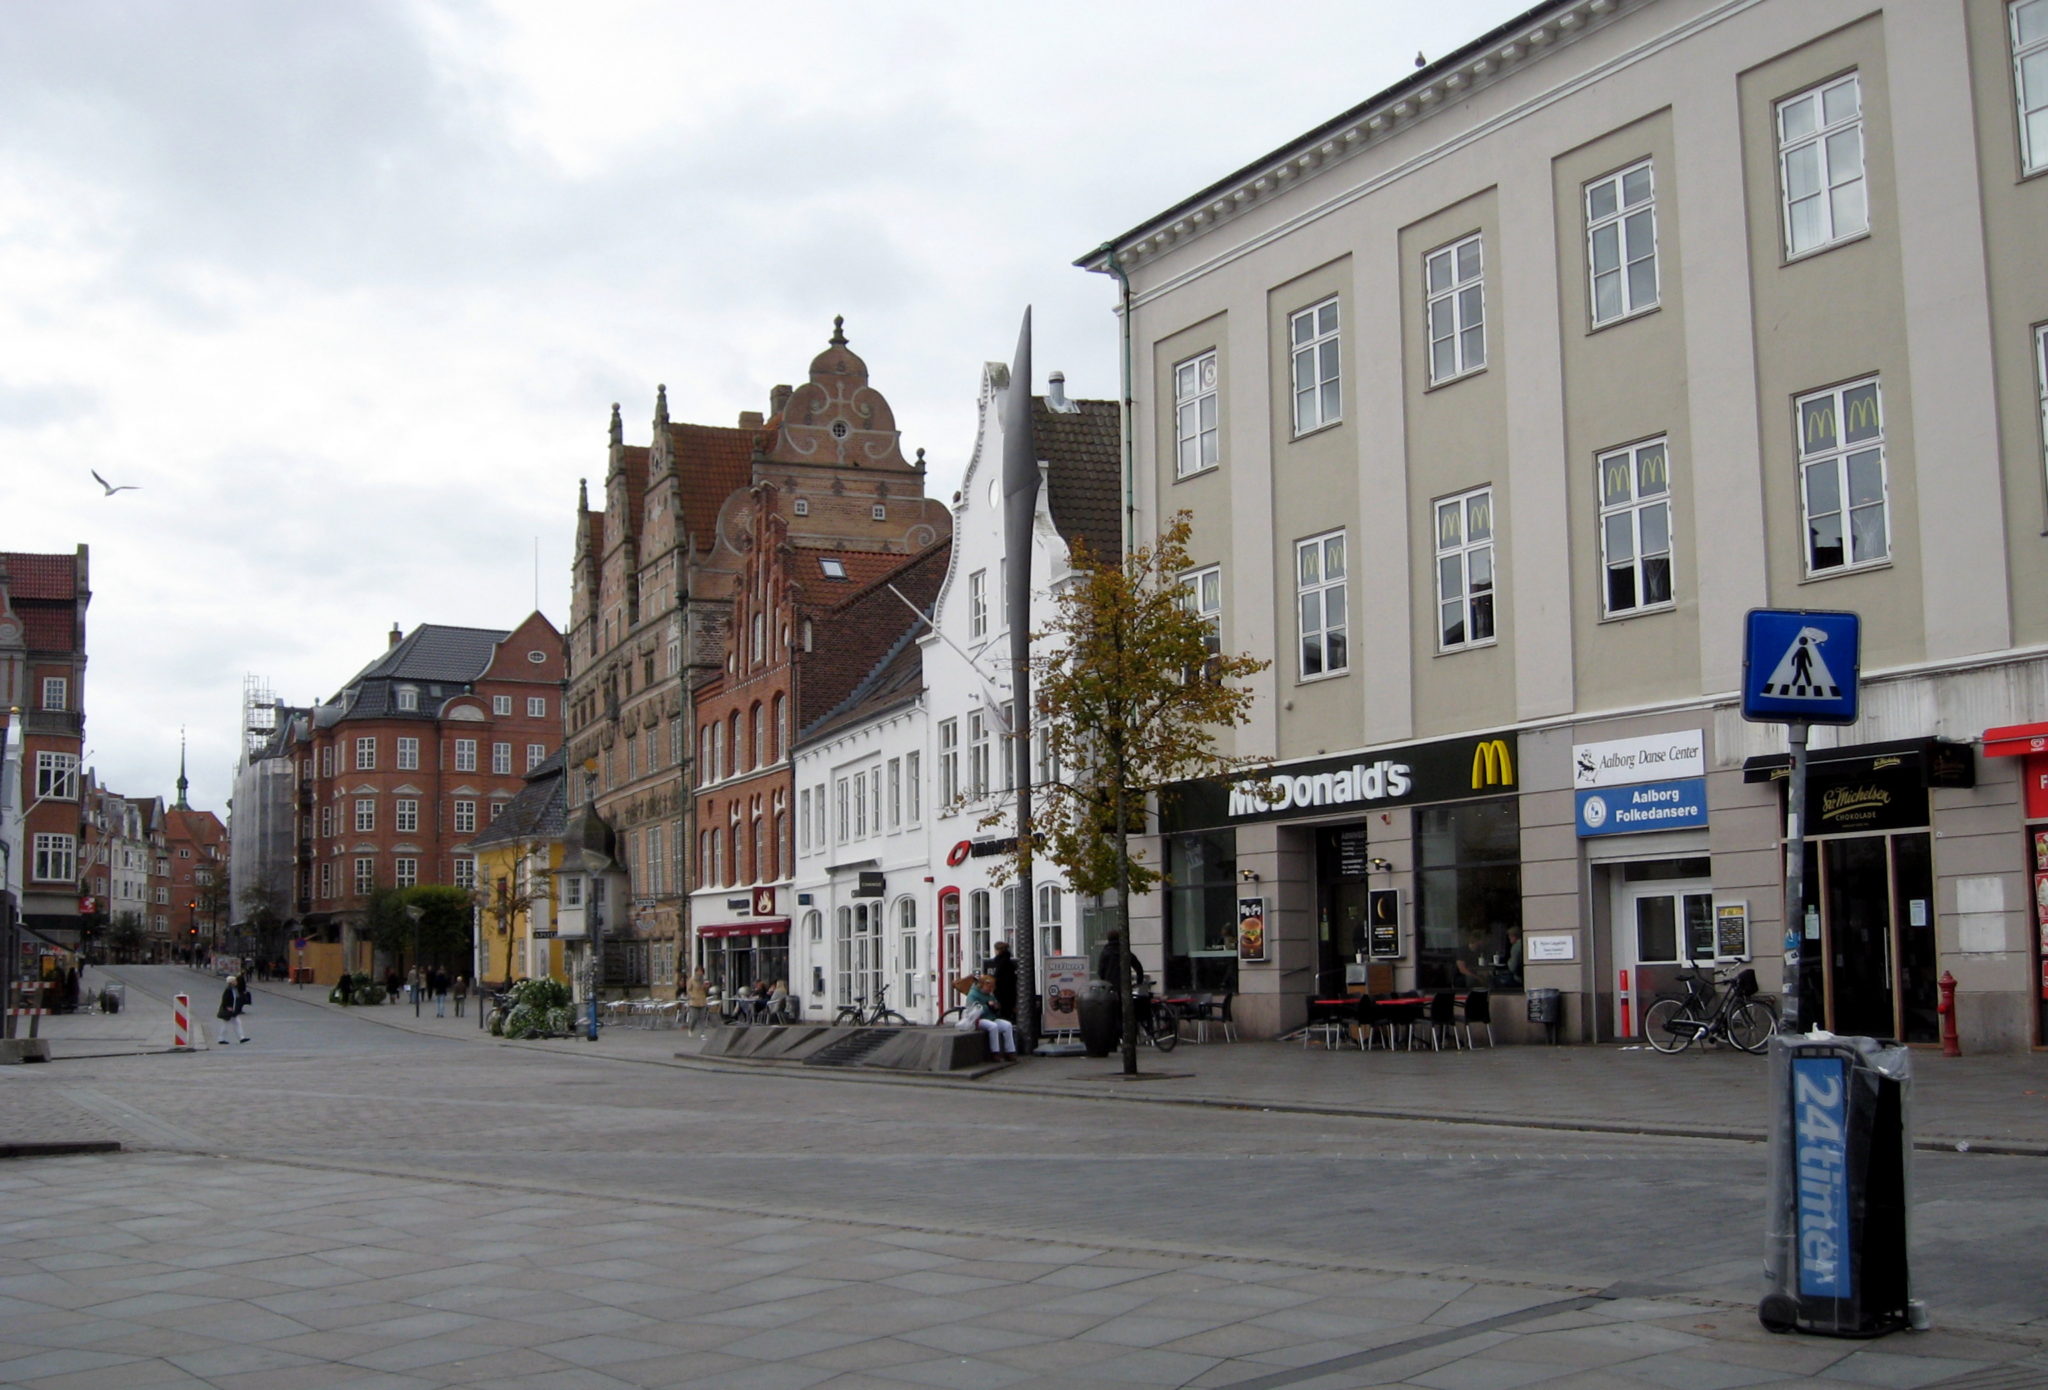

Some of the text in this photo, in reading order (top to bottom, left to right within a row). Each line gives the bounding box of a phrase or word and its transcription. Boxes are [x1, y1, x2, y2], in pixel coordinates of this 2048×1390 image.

[1600, 745, 1699, 769] Aalborg Danse Center
[1229, 761, 1411, 816] McDonald's
[1632, 789, 1680, 804] Aalborg
[1835, 785, 1891, 807] Michelsen
[1616, 805, 1698, 822] Folkedansere
[1835, 811, 1877, 821] CHOKOLADE
[1797, 1071, 1842, 1284] 24timer
